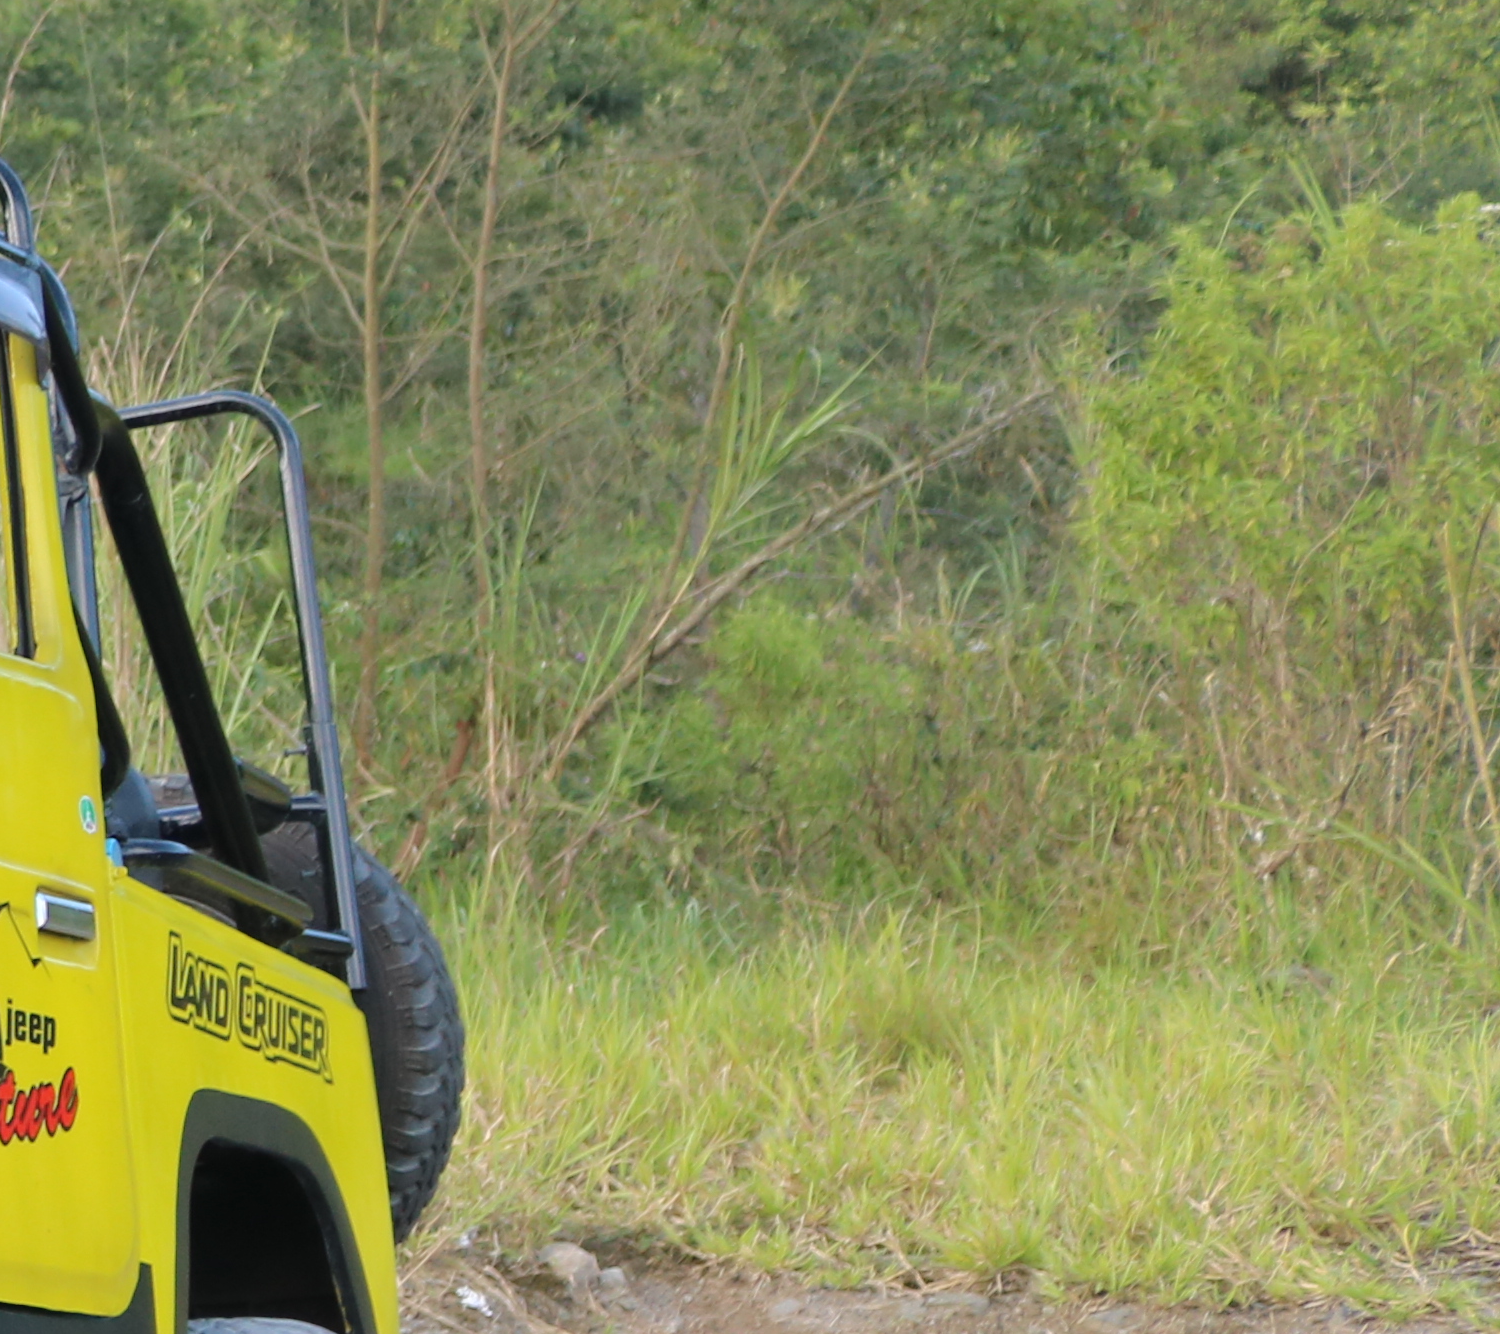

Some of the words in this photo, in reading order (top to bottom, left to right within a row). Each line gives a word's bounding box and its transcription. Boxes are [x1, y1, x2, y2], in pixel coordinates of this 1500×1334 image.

[5, 999, 57, 1055] jeep
[167, 930, 232, 1042] LAND
[236, 962, 334, 1084] CRUISER
